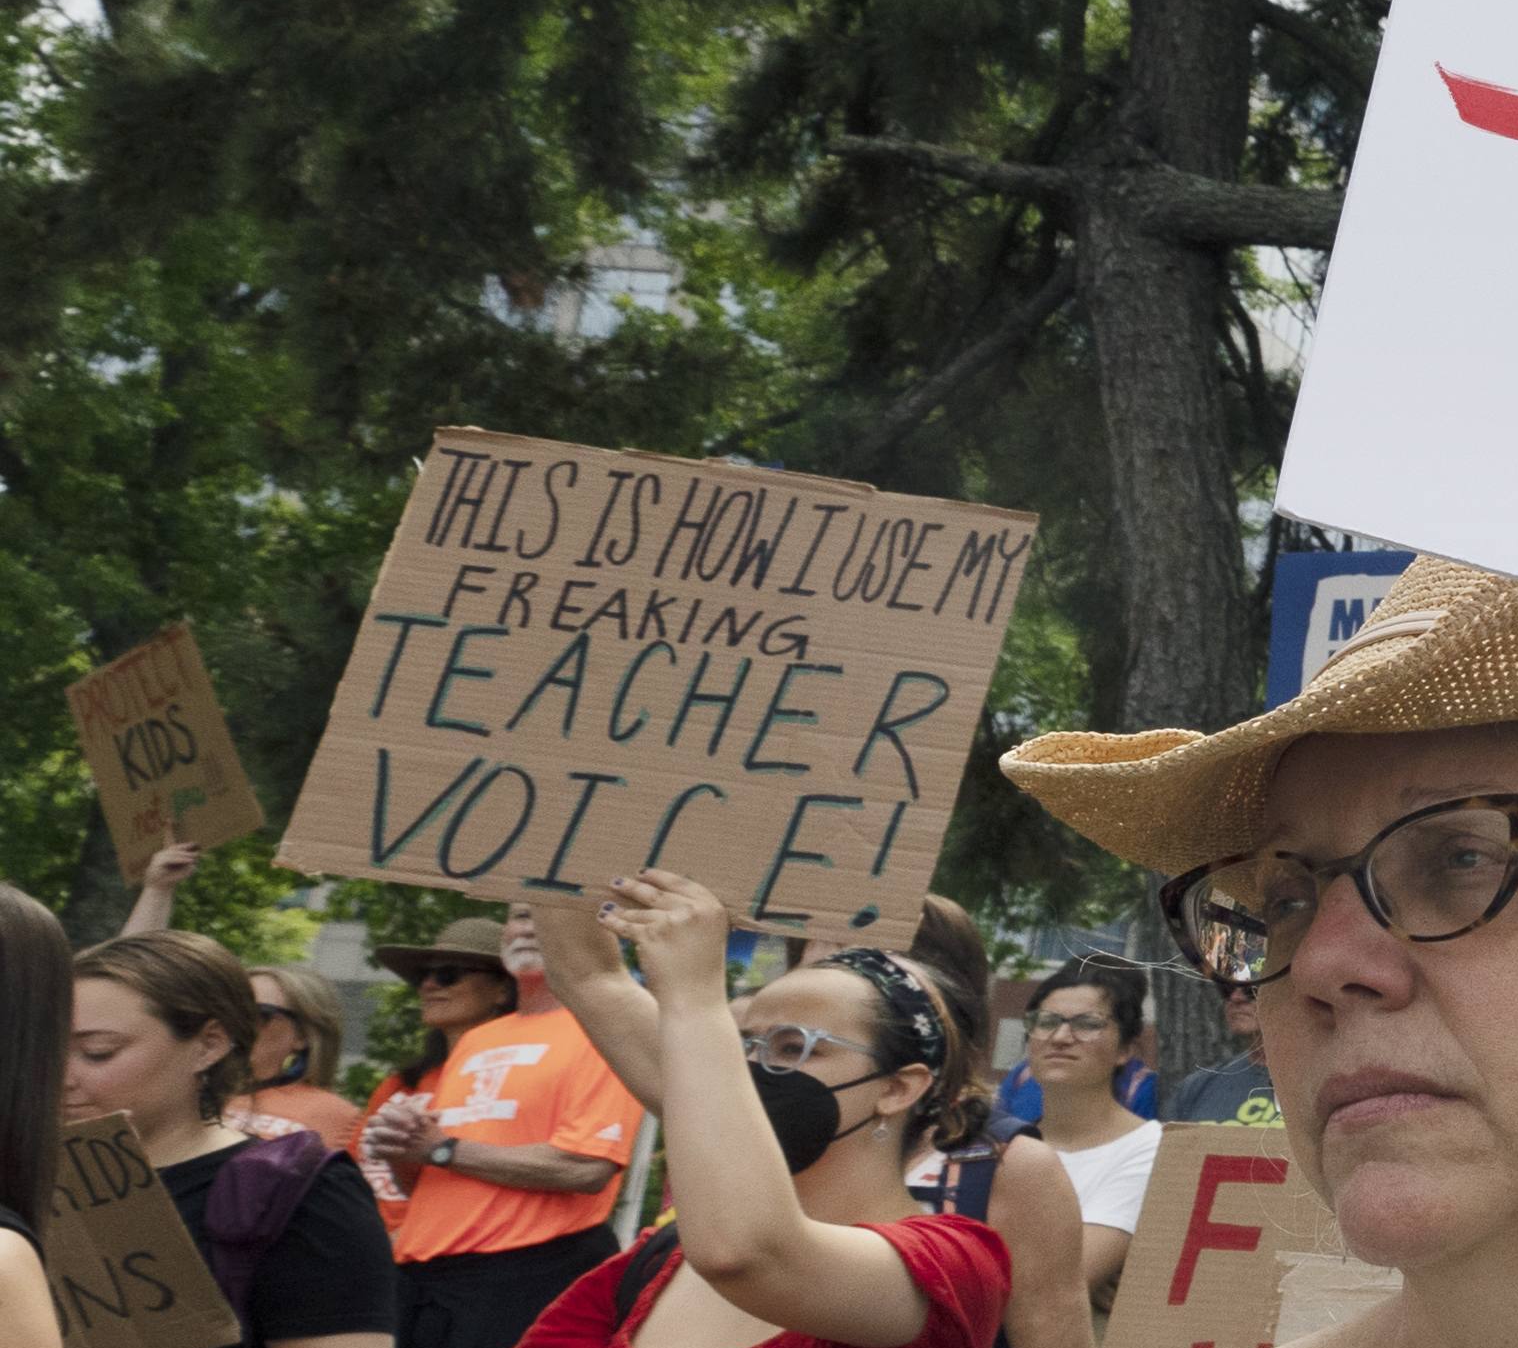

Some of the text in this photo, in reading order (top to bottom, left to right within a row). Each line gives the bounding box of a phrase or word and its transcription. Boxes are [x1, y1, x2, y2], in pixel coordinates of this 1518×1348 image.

[424, 447, 1033, 624] THIS IS HOW I USE MY
[441, 563, 810, 661] FREAKING
[112, 702, 198, 792] KIDS
[368, 611, 953, 801] TEACHER
